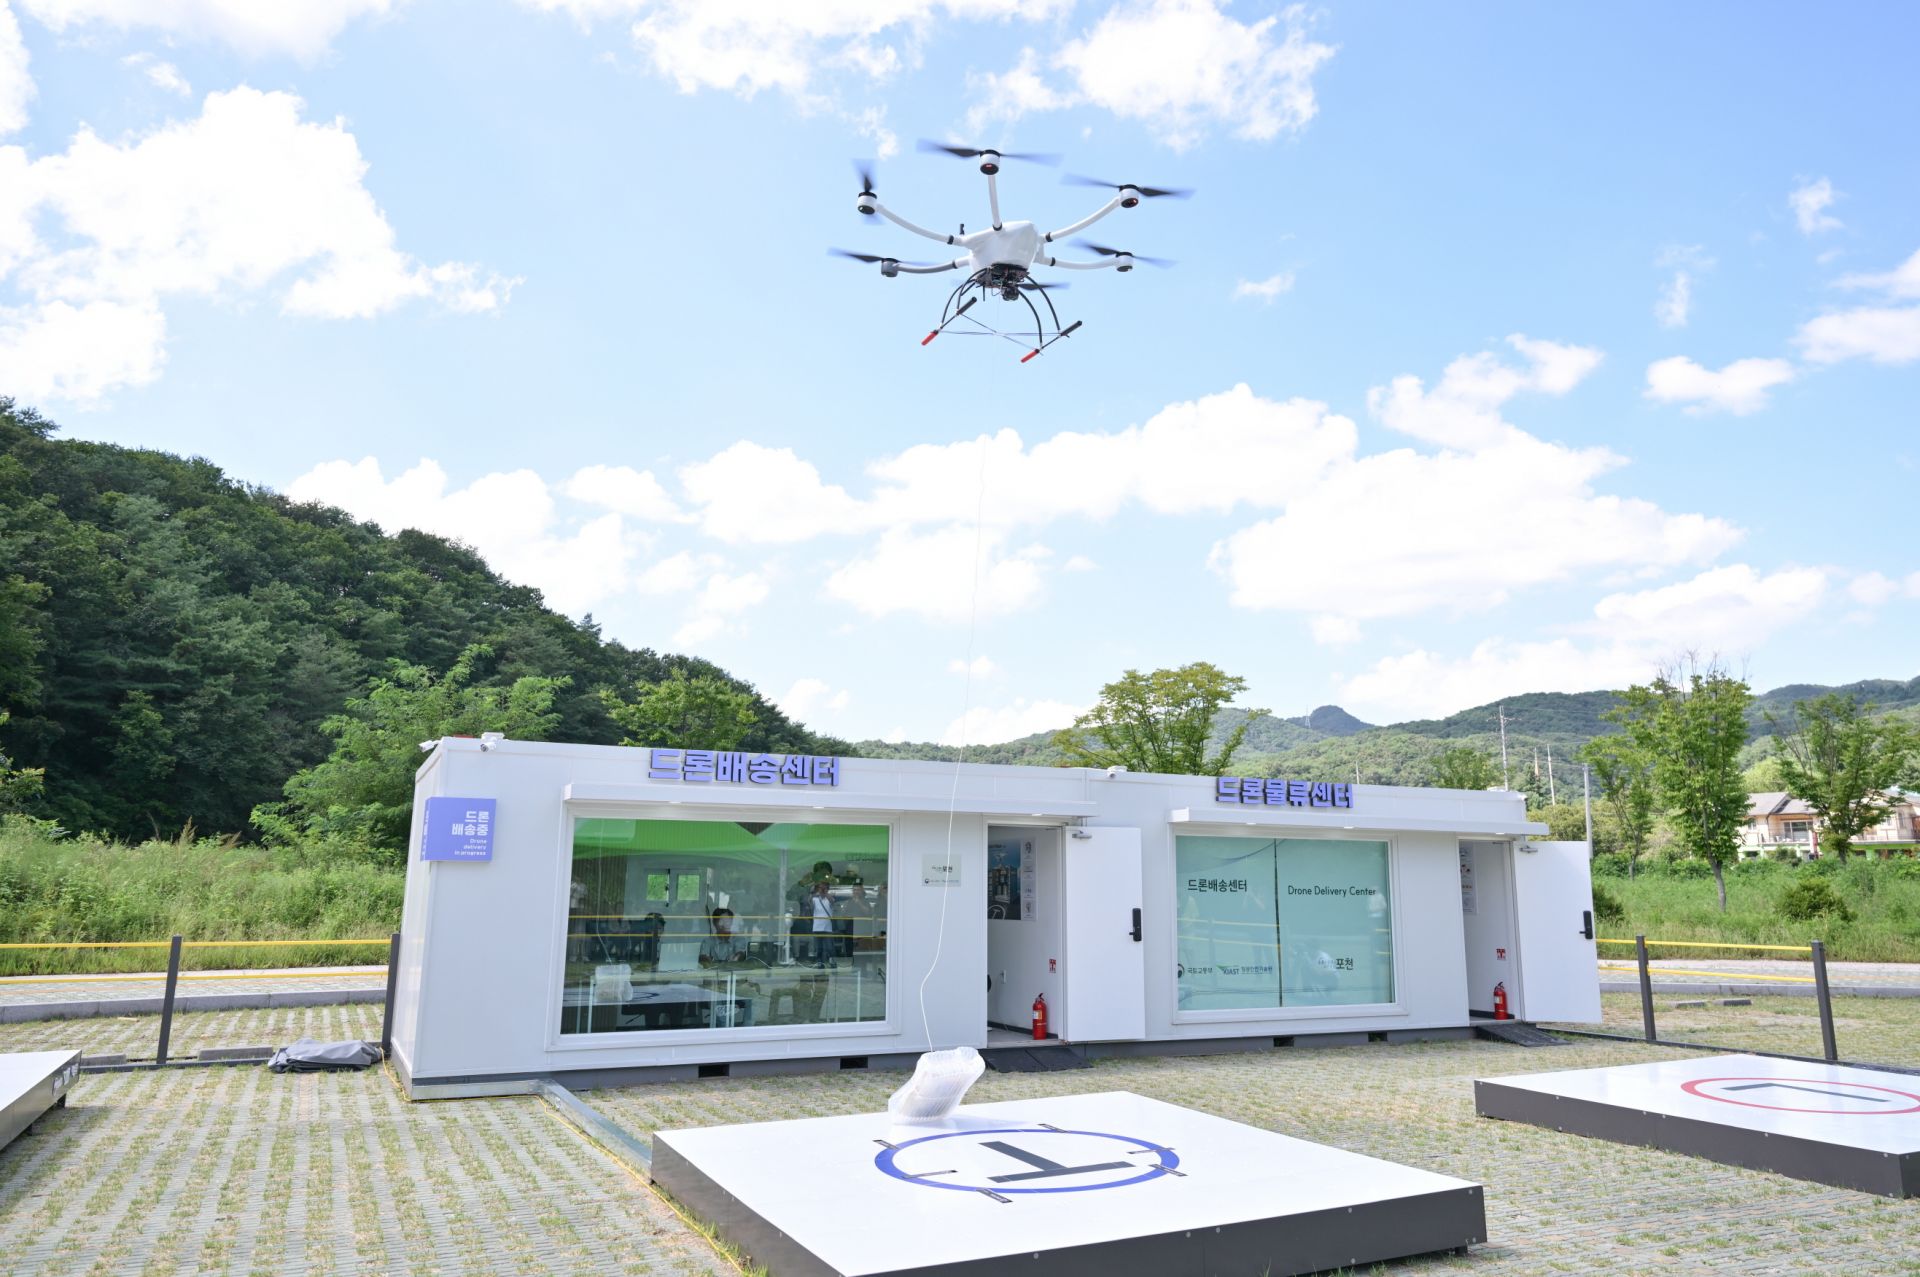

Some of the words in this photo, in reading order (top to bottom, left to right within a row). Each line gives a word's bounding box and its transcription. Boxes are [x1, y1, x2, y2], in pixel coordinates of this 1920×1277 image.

[649, 749, 840, 786] 드론배송센터
[1216, 776, 1354, 808] 드론물류센터
[465, 811, 489, 823] 드론
[451, 823, 489, 836] 배송중
[1187, 878, 1248, 893] 드론배송센터
[1287, 885, 1313, 896] Drone
[1314, 885, 1347, 898] Delivery
[1349, 886, 1377, 897] Center
